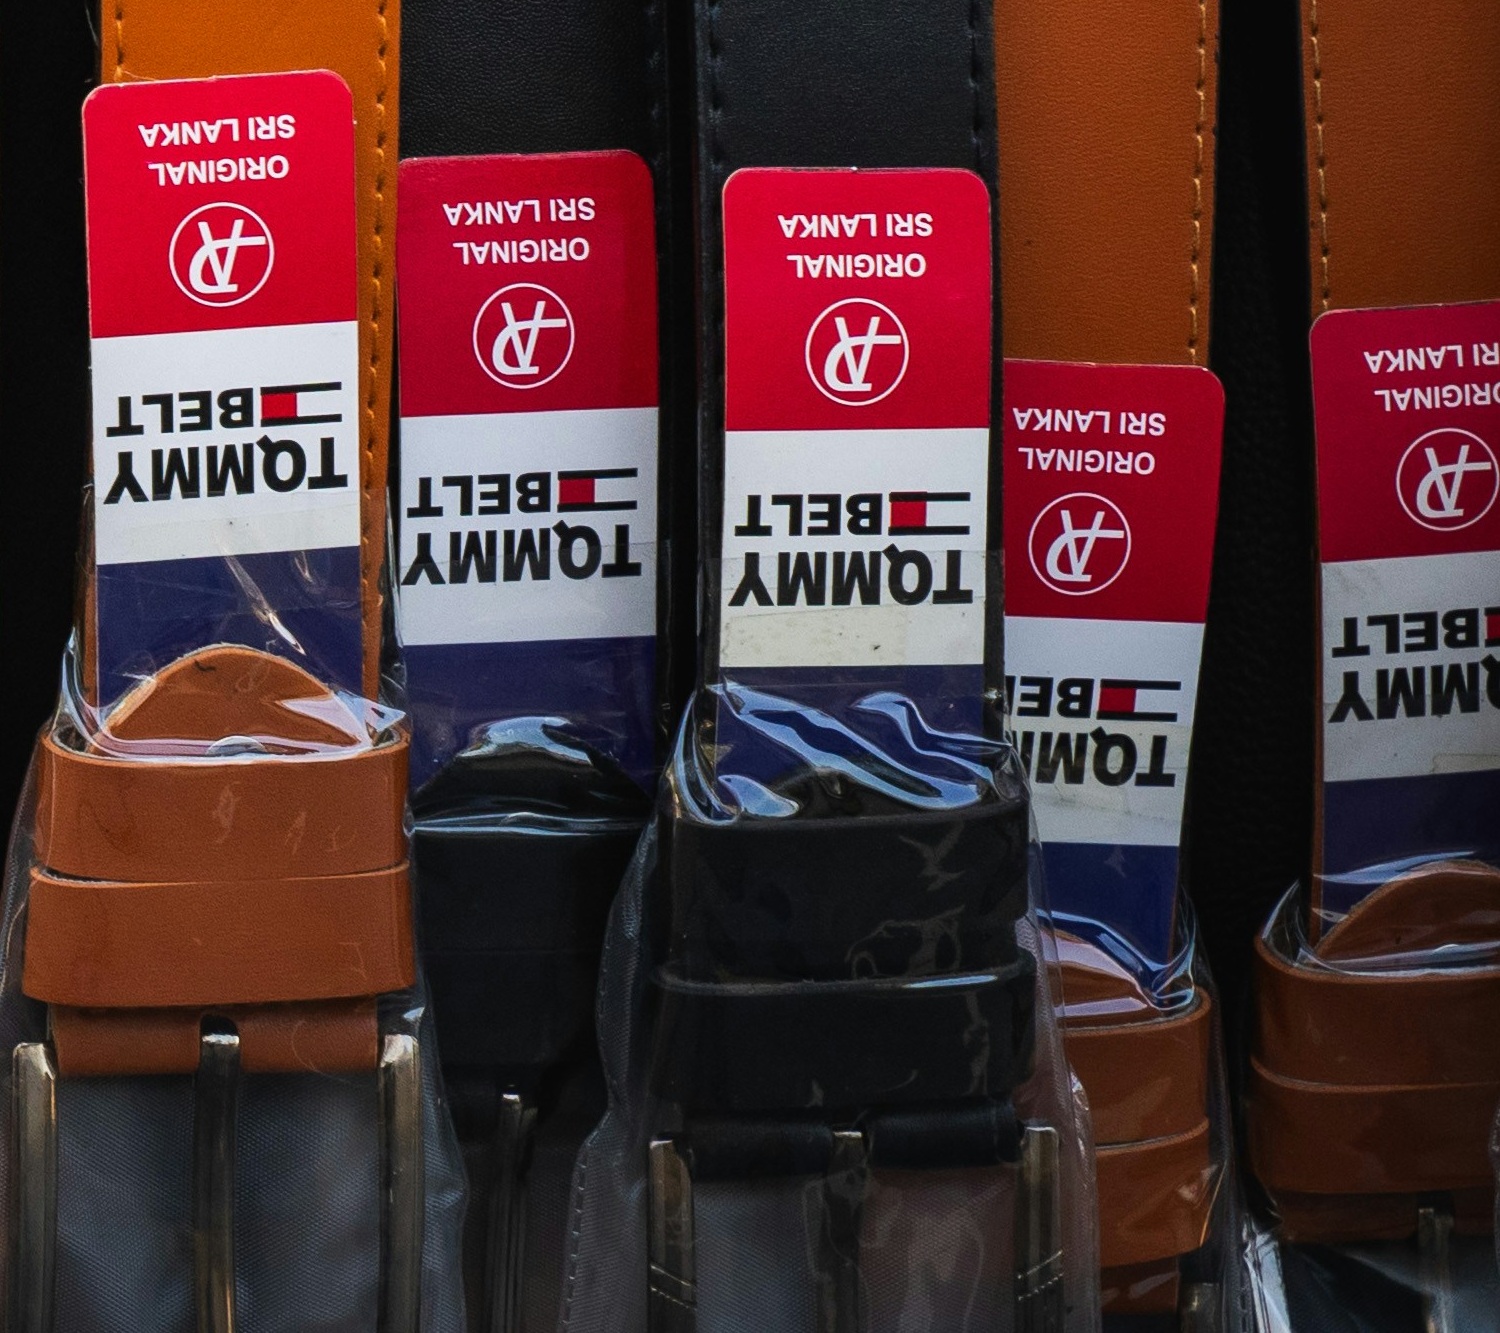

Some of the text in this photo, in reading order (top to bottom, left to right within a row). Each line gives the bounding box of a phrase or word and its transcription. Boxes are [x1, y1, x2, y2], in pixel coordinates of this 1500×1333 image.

[139, 115, 297, 148] SRI LANKA
[149, 155, 290, 187] ORIGINAL
[442, 197, 596, 226] SRI LANKA
[777, 211, 934, 239] SRI LANKA
[452, 237, 590, 263] ORIGINAL
[786, 251, 928, 279] ORIGINAL
[1364, 344, 1464, 374] LANKA
[106, 387, 255, 437] BELT
[1374, 382, 1500, 412] RIGINAL
[1011, 407, 1167, 436] SRI LANKA
[1017, 446, 1157, 475] ORIGINAL
[405, 472, 552, 517] BELT
[733, 492, 883, 536] BELT
[1331, 607, 1479, 658] BELT
